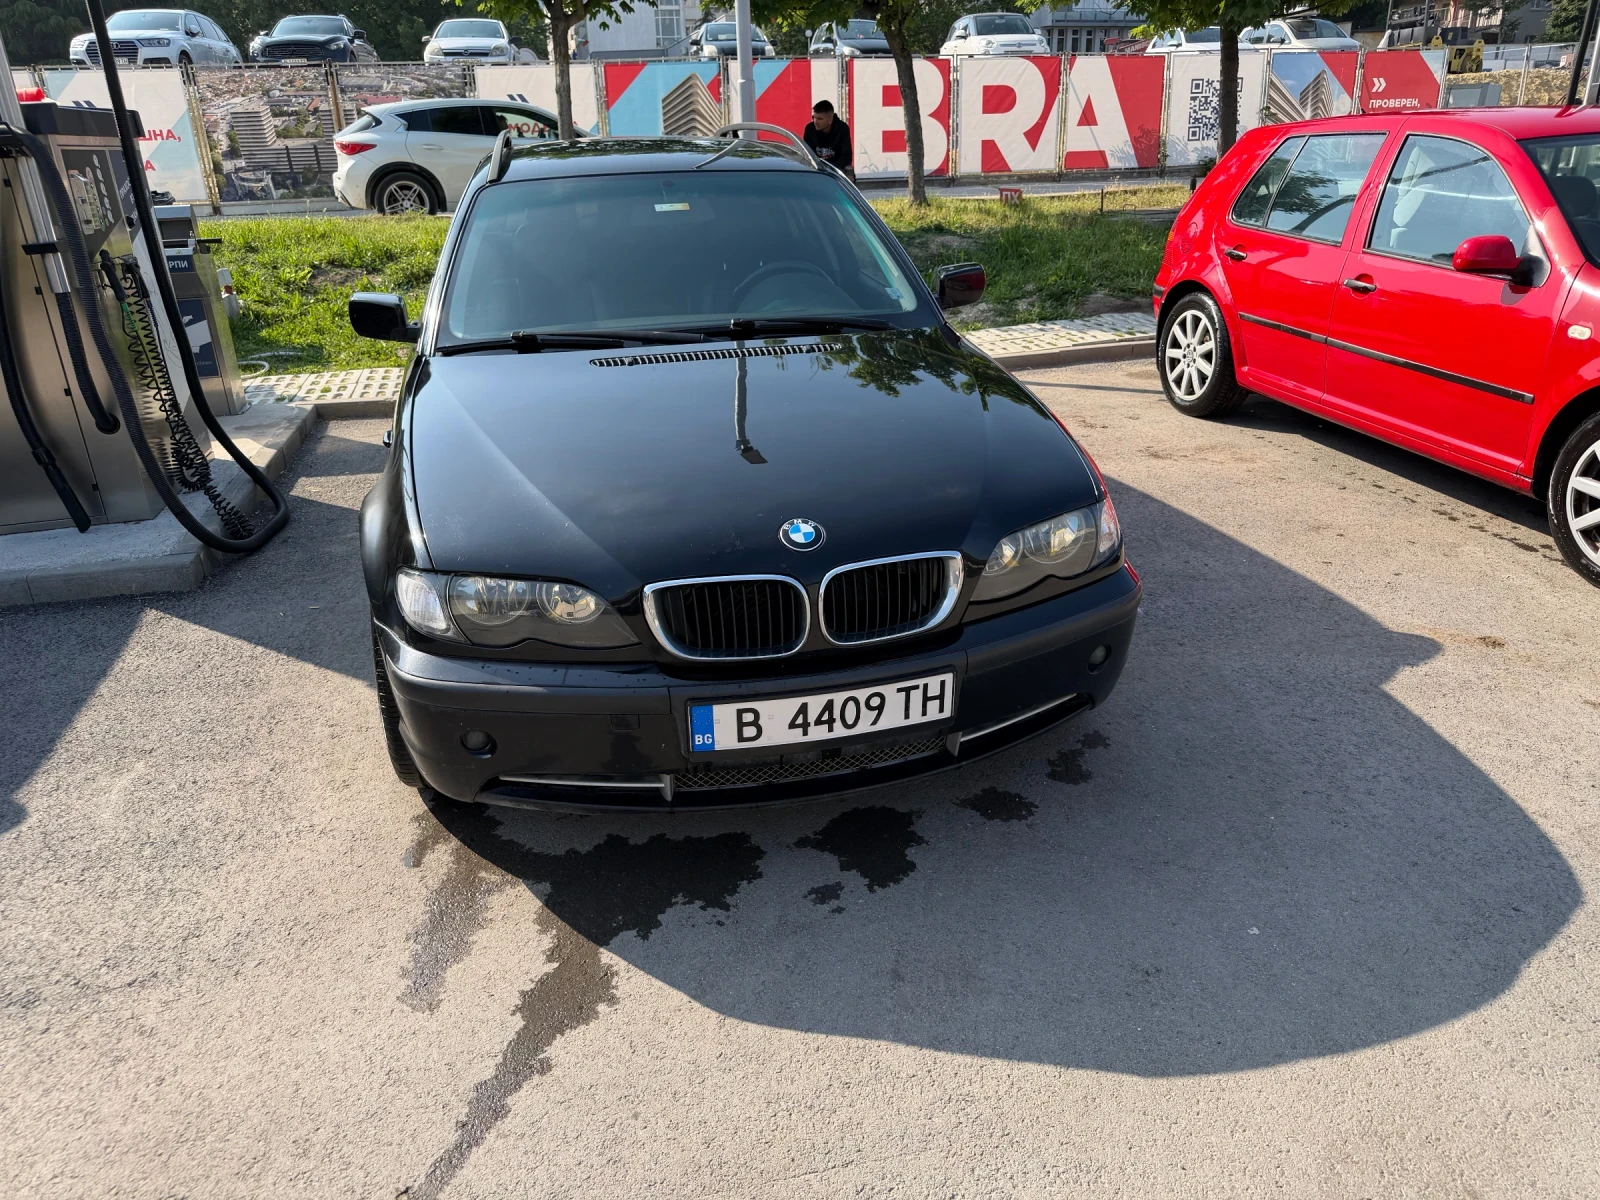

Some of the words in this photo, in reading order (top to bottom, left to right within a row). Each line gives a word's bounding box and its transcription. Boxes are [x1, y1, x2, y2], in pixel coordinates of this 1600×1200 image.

[1369, 98, 1420, 108] ПРОВЕРЕН,
[1002, 191, 1020, 205] ПХ
[783, 519, 816, 530] BMW
[736, 708, 763, 743] B
[788, 692, 886, 736] 4409
[896, 679, 946, 720] TH
[695, 734, 713, 745] BG
